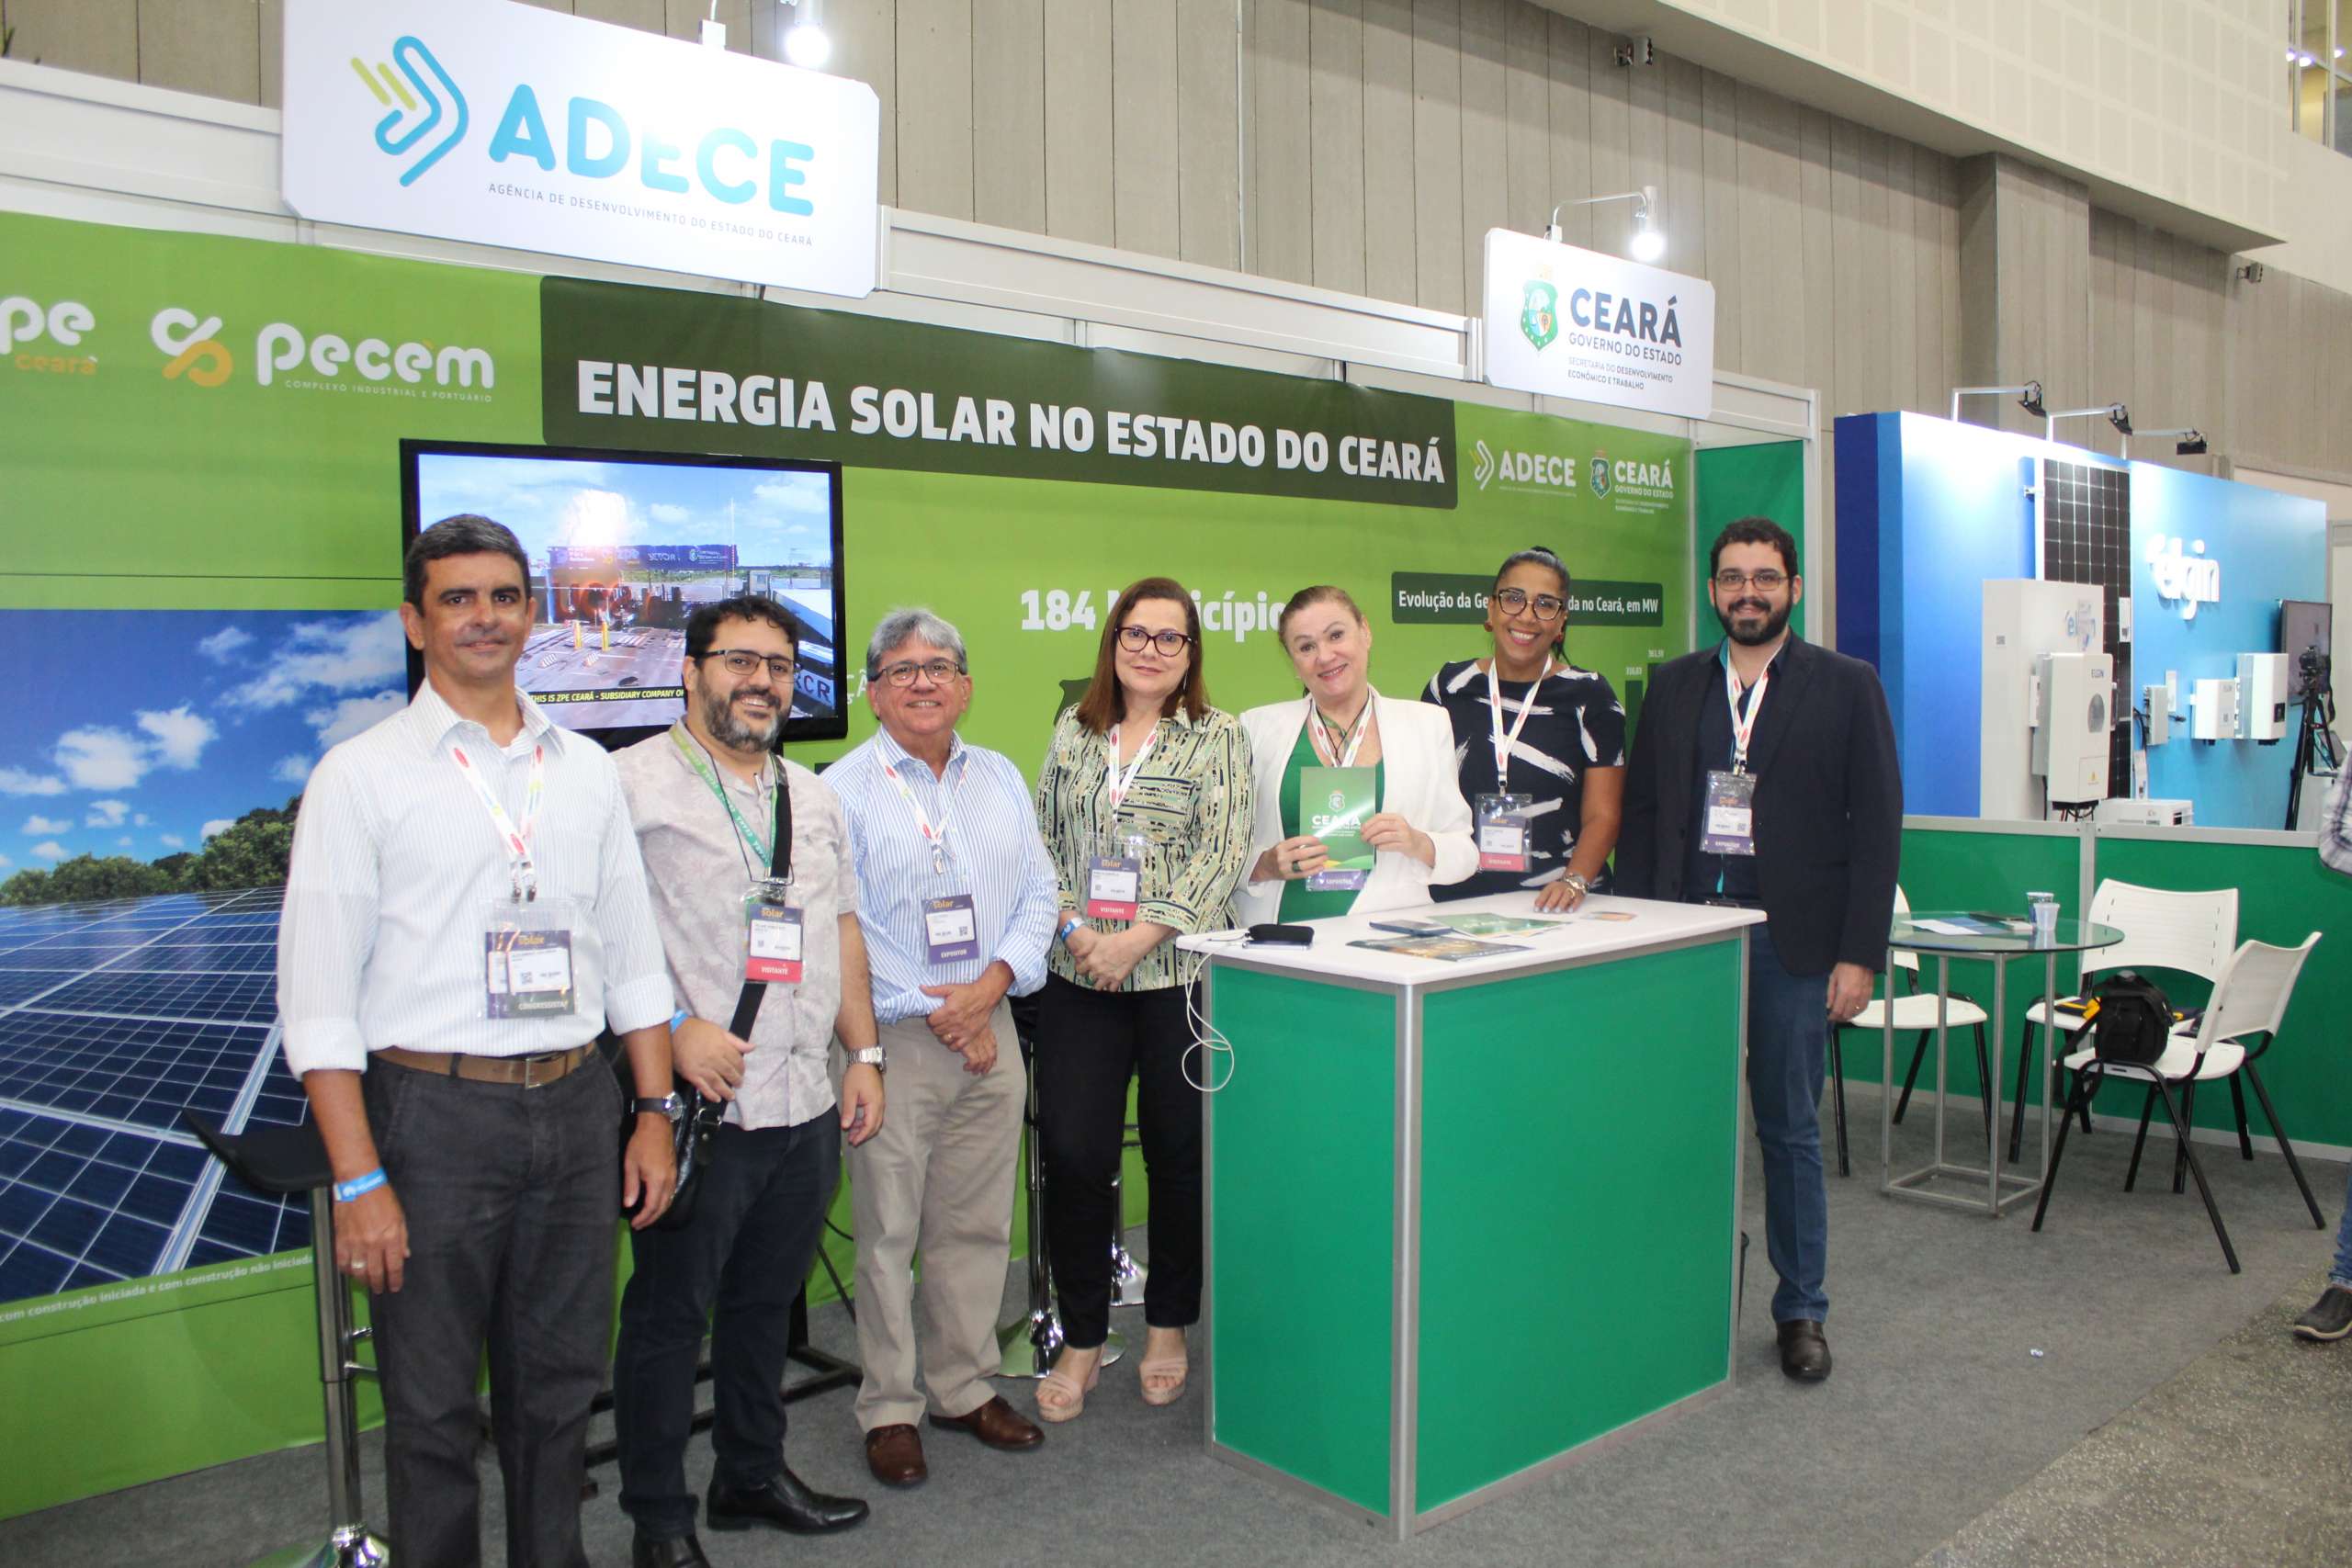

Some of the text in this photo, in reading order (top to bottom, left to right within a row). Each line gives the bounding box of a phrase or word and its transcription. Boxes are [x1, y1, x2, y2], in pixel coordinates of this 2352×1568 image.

[489, 84, 815, 217] ADECE
[488, 183, 813, 247] AGÊNCIA DE DESENVOLVIMENTO DO ESTADO DO CEARÁ
[0, 296, 96, 355] pe
[1570, 288, 1682, 349] CEARÁ
[1568, 332, 1682, 366] GOVERNO DO ESTADO
[285, 379, 348, 392] COMPLEXO
[353, 385, 416, 398] INDUSTRIAL
[1567, 369, 1607, 383] ECONÔMICO
[1612, 377, 1645, 390] TRABALHO
[1617, 366, 1673, 383] DESENVOLVIMENTO
[577, 359, 1446, 484] ENERGIA SOLAR NO ESTADO DO CEARÁ
[1498, 450, 1577, 488] ADECE
[1614, 458, 1674, 489] CEARÁ
[1021, 589, 1096, 631] 184
[1398, 590, 1454, 613] Evolução
[1457, 591, 1471, 608] da
[1582, 599, 1594, 611] no
[1596, 596, 1625, 615] Ceará,
[1626, 601, 1641, 613] em
[1643, 598, 1659, 613] MW
[548, 694, 556, 702] IS
[557, 693, 571, 702] ZPE
[571, 691, 594, 701] CEARÁ
[600, 689, 641, 700] SUBSIDIARY
[641, 690, 673, 699] COMPANY
[28, 1295, 97, 1317] construção
[100, 1286, 147, 1303] iniciada
[159, 1280, 184, 1292] com
[186, 1266, 248, 1286] construção
[250, 1262, 271, 1275] não
